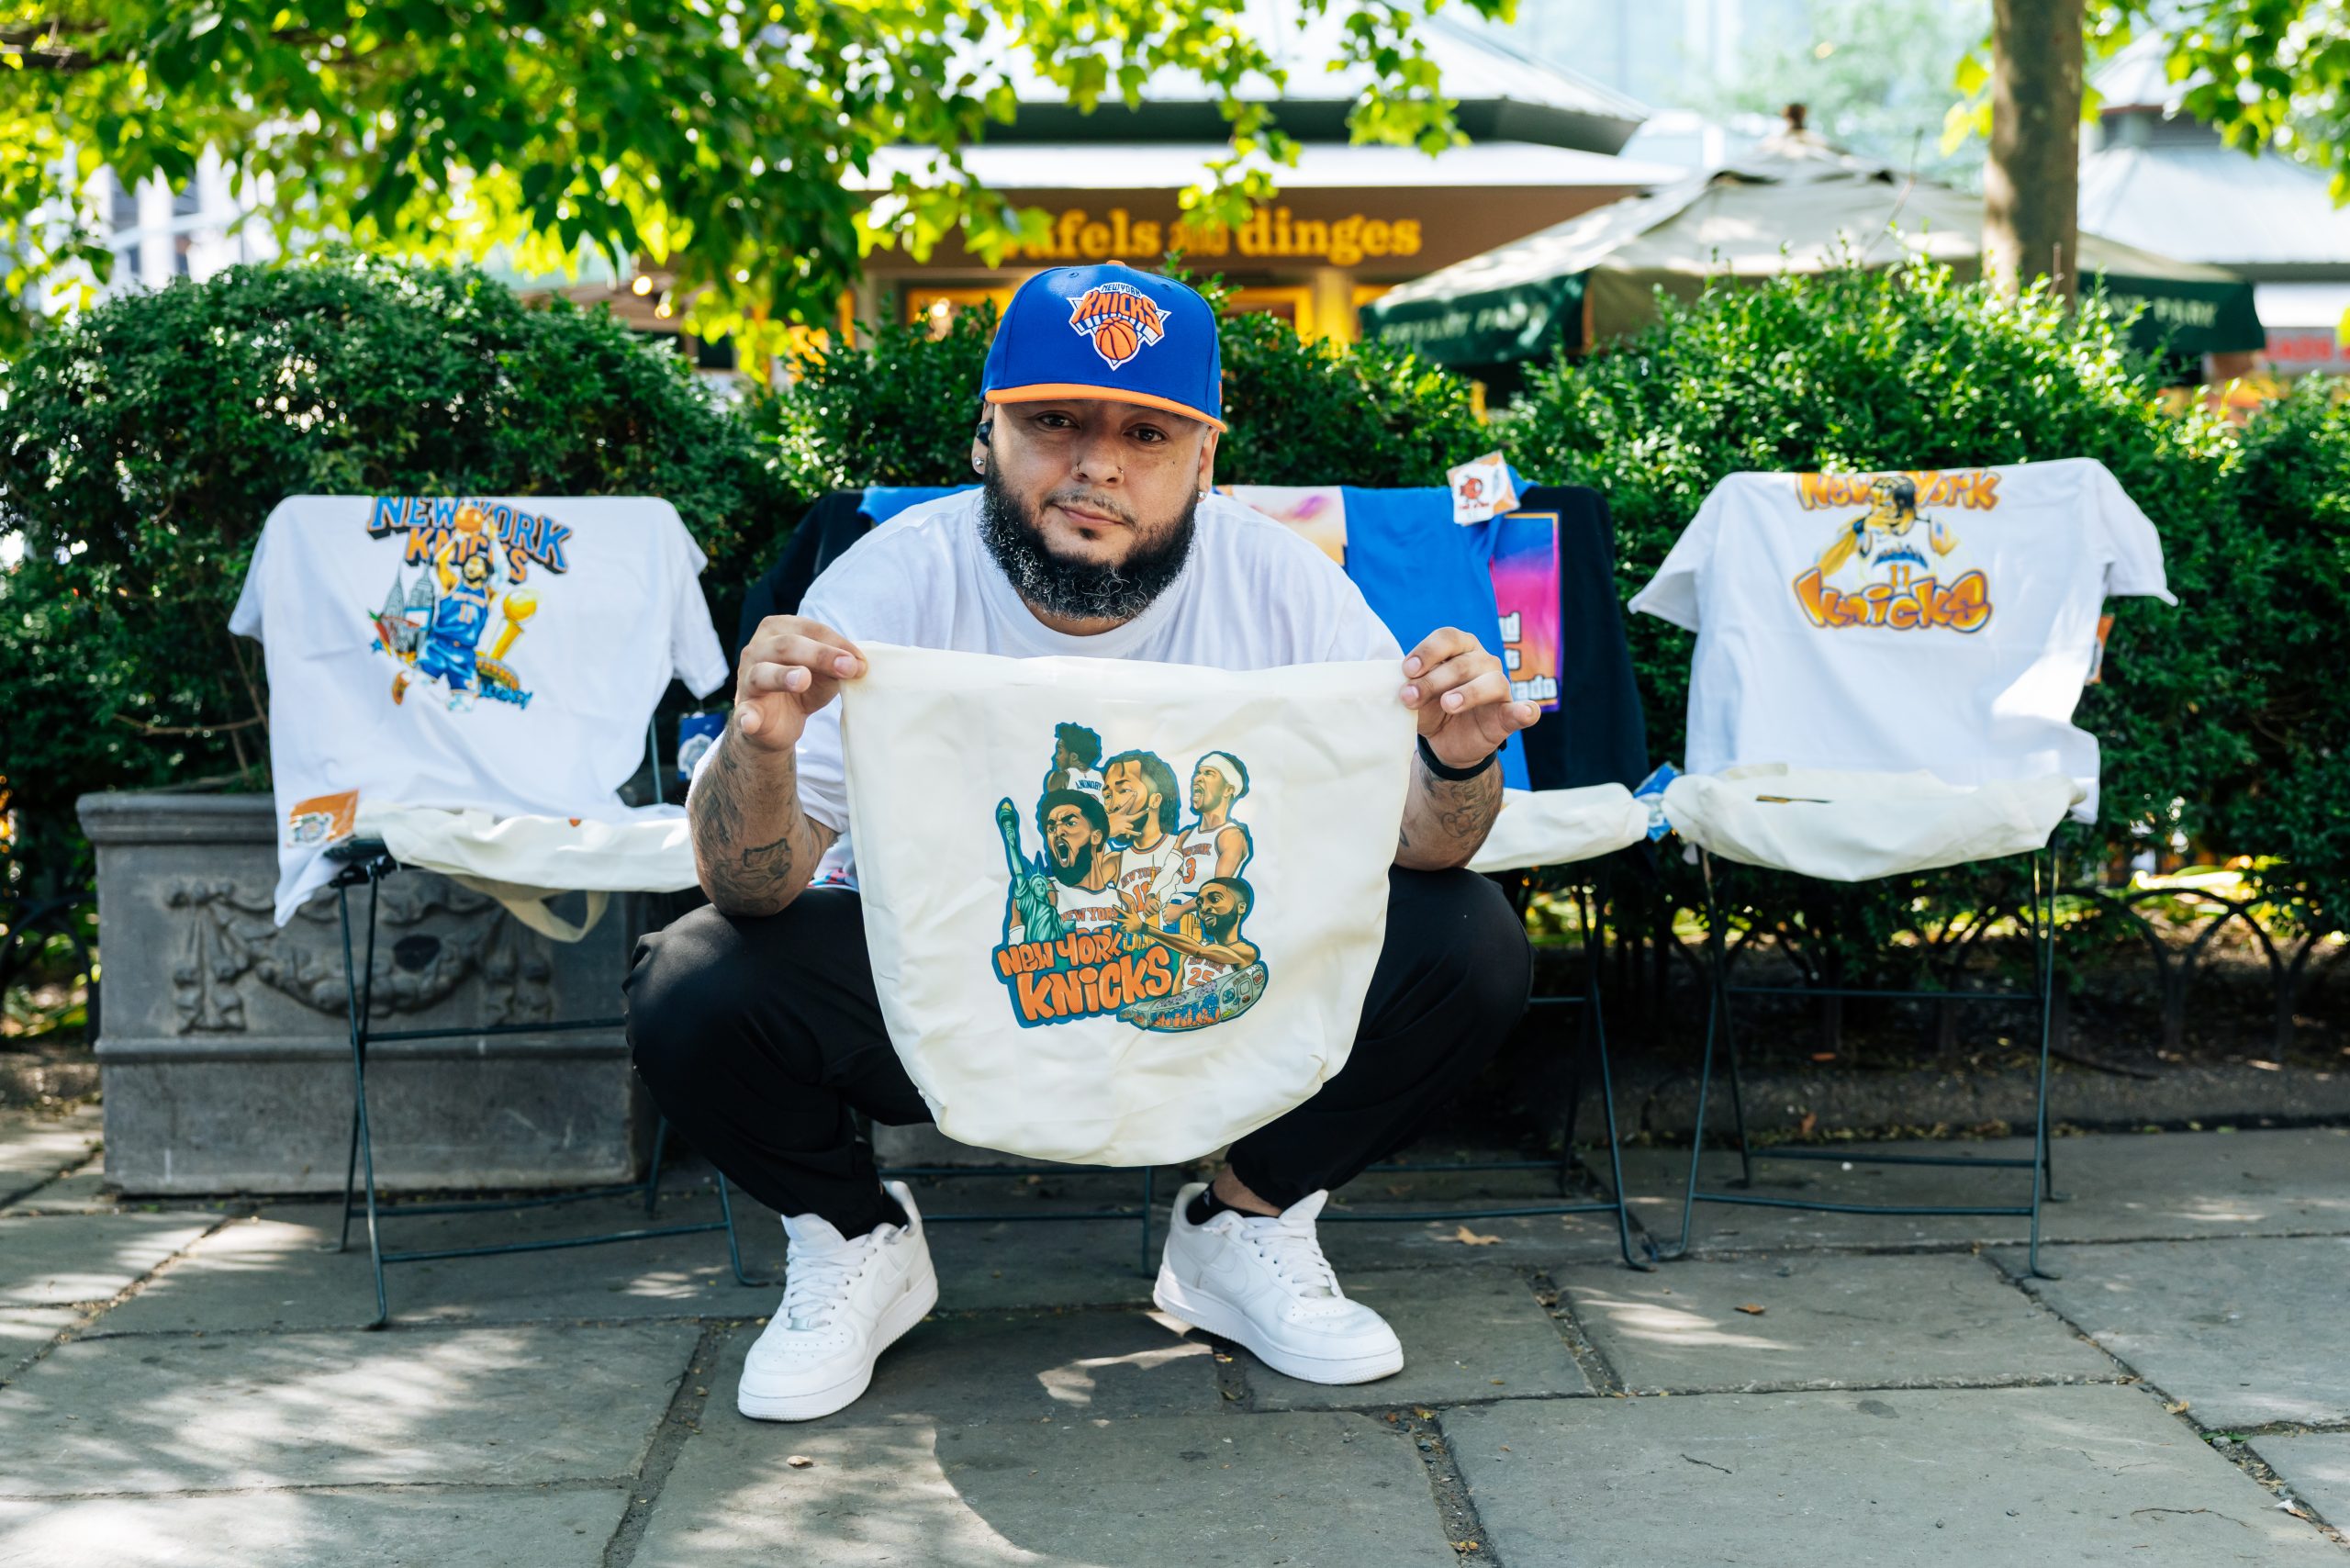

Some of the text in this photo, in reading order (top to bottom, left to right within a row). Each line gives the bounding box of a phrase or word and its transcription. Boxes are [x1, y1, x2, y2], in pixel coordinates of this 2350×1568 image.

[1237, 206, 1423, 266] dinges
[1102, 283, 1142, 297] NEW YORK
[1071, 289, 1163, 337] KNICKS
[368, 497, 458, 535] NEW
[1889, 565, 1910, 588] 11
[1182, 857, 1196, 884] 3
[1187, 967, 1214, 986] 25
